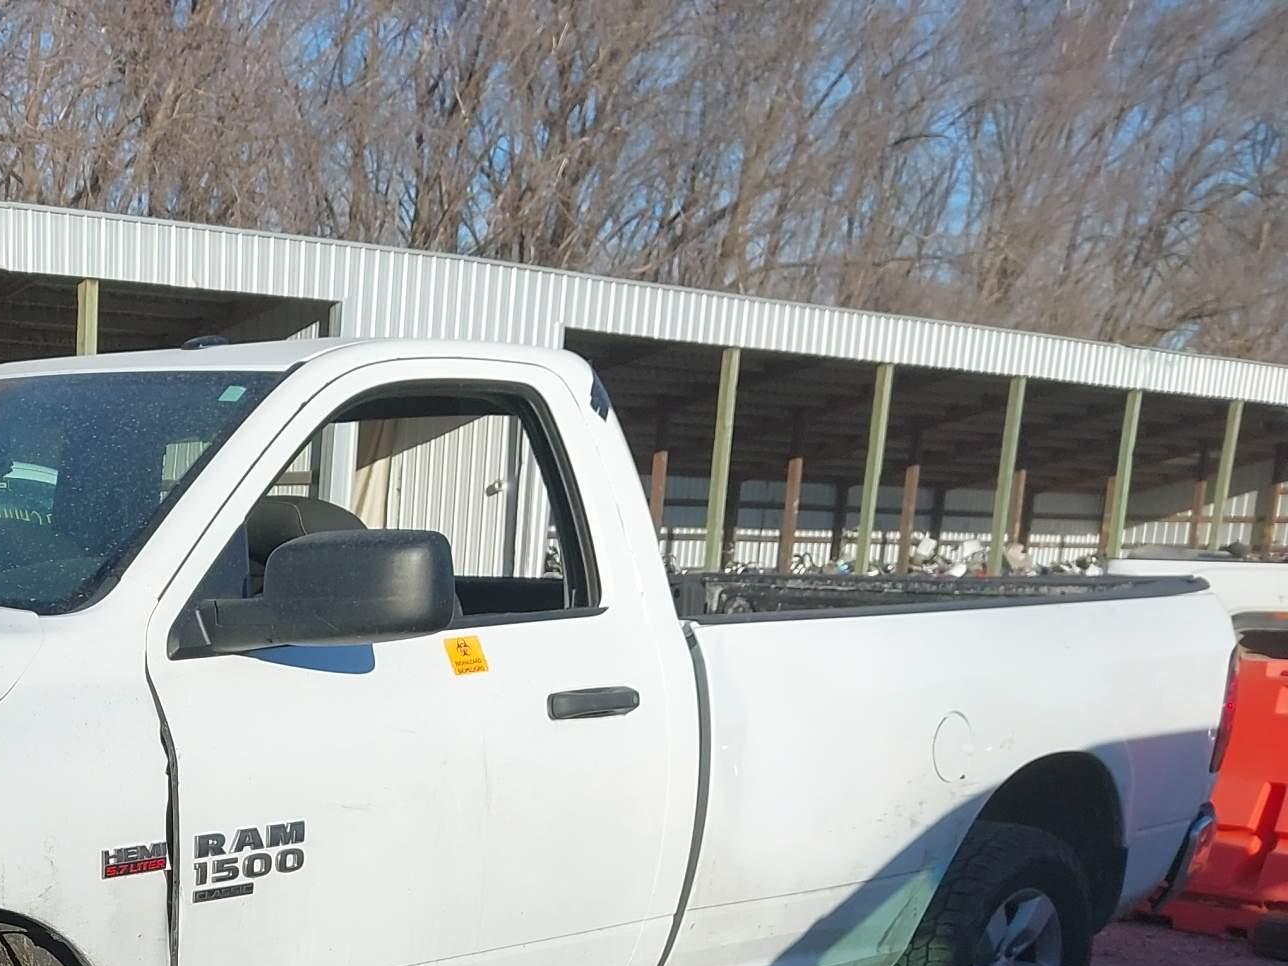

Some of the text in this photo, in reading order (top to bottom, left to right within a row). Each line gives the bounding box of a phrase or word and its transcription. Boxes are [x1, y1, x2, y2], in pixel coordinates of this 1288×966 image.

[194, 820, 306, 859] RAM
[101, 842, 167, 864] HEMI
[129, 859, 166, 874] LITER
[194, 848, 306, 887] 1500
[194, 883, 254, 902] CLASSIC
